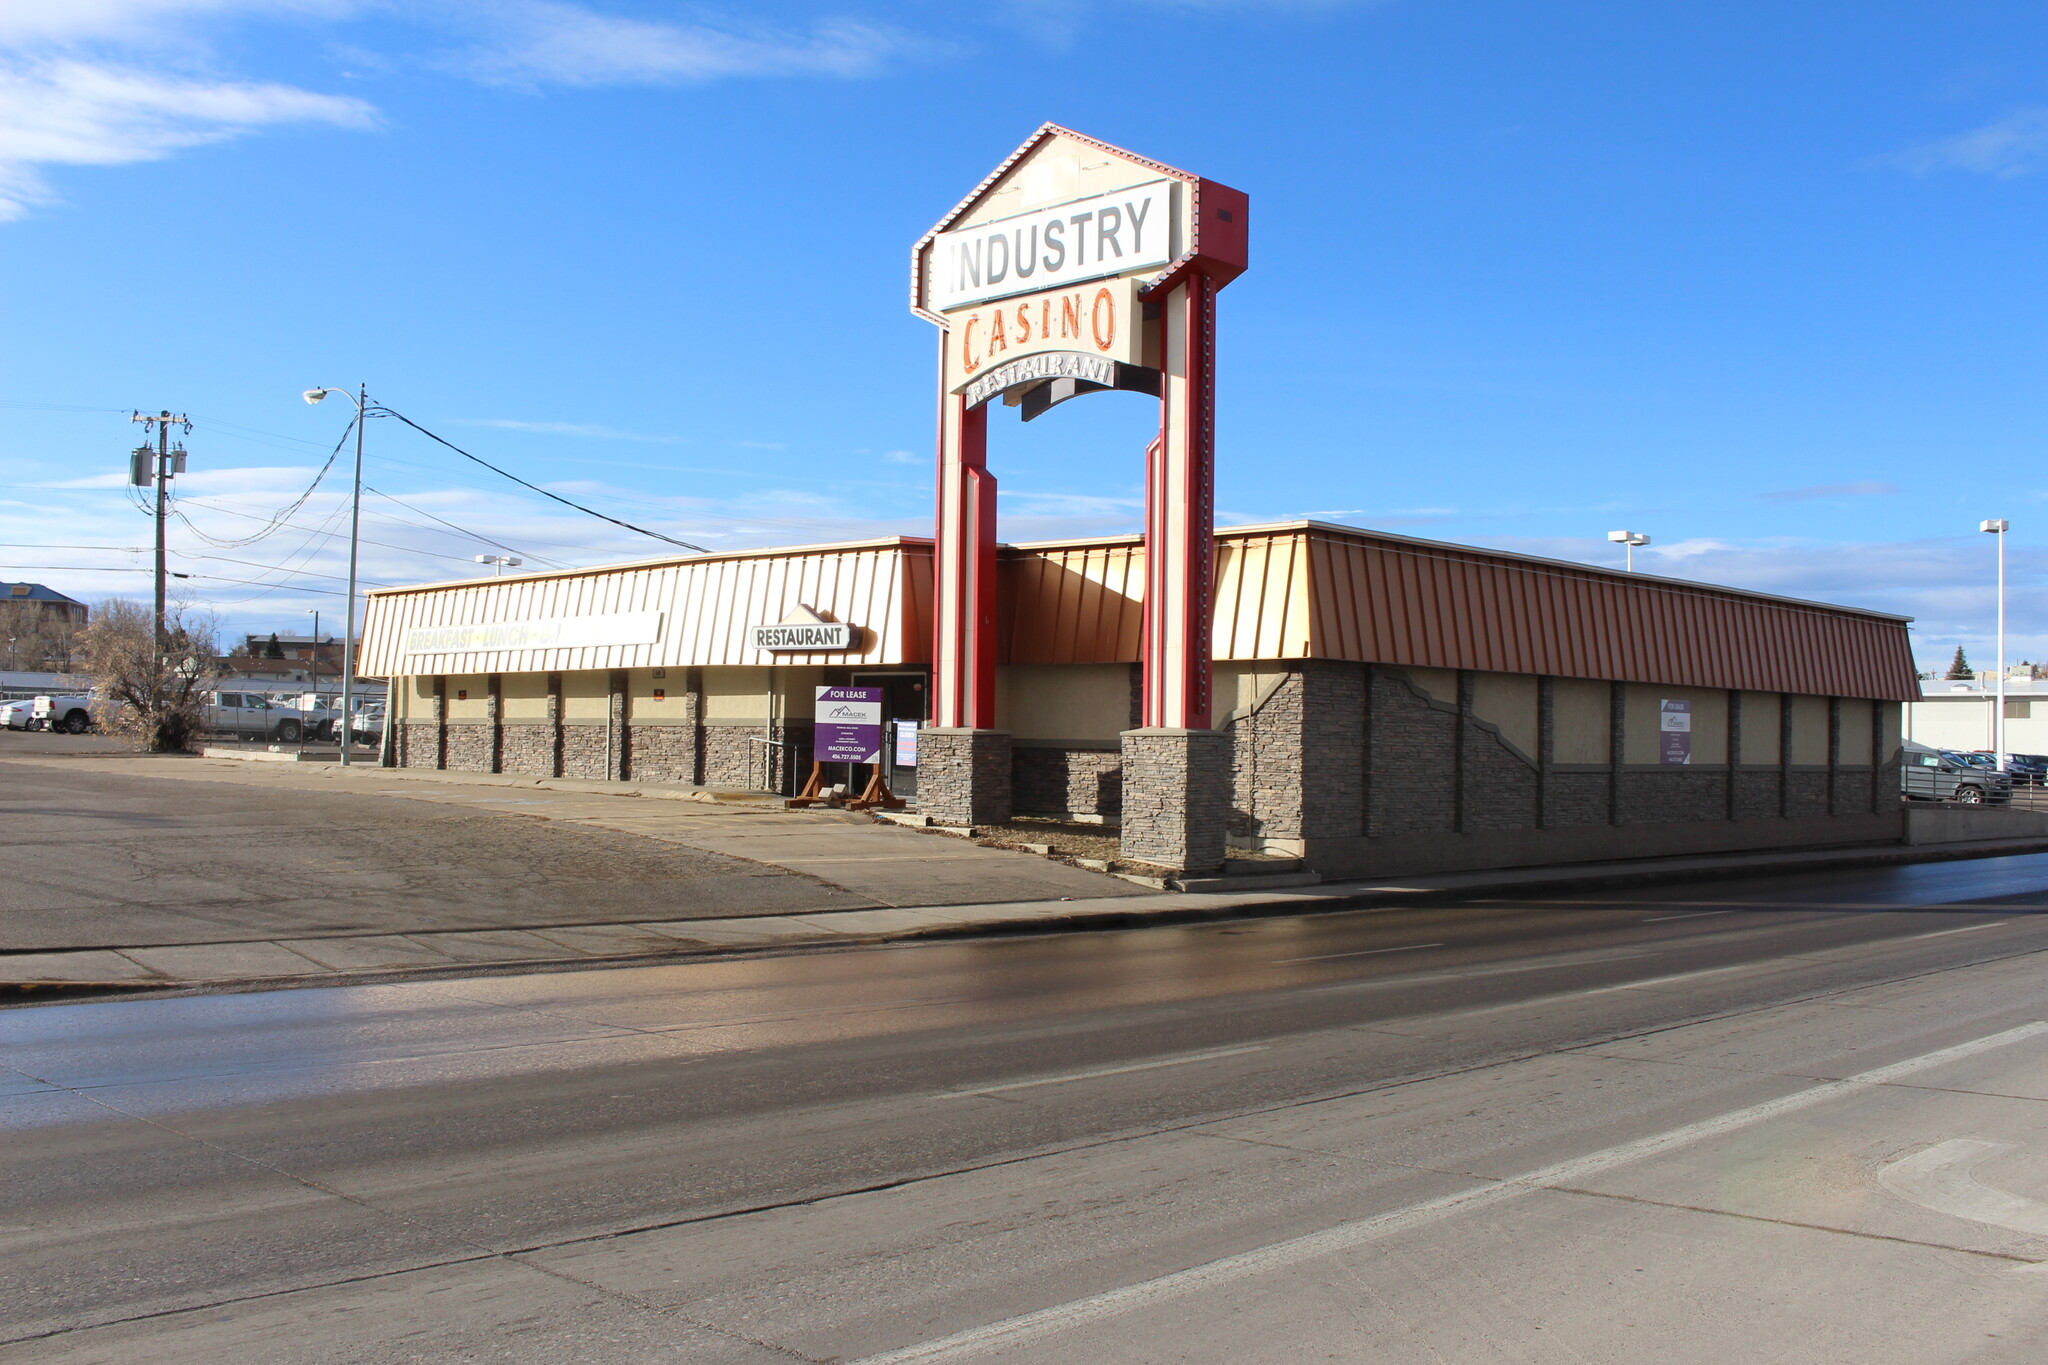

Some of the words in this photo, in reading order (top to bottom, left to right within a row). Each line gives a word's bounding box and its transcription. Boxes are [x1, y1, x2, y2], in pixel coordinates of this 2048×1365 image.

[949, 197, 1152, 294] INDUSTRY
[963, 287, 1115, 375] CASINO
[967, 353, 1115, 405] RESTAURANT
[409, 628, 475, 651] BREAKFAST
[482, 625, 529, 648] LUNCH
[757, 627, 842, 646] RESTAURANT
[830, 690, 845, 699] FOR
[846, 690, 867, 699] LEASE
